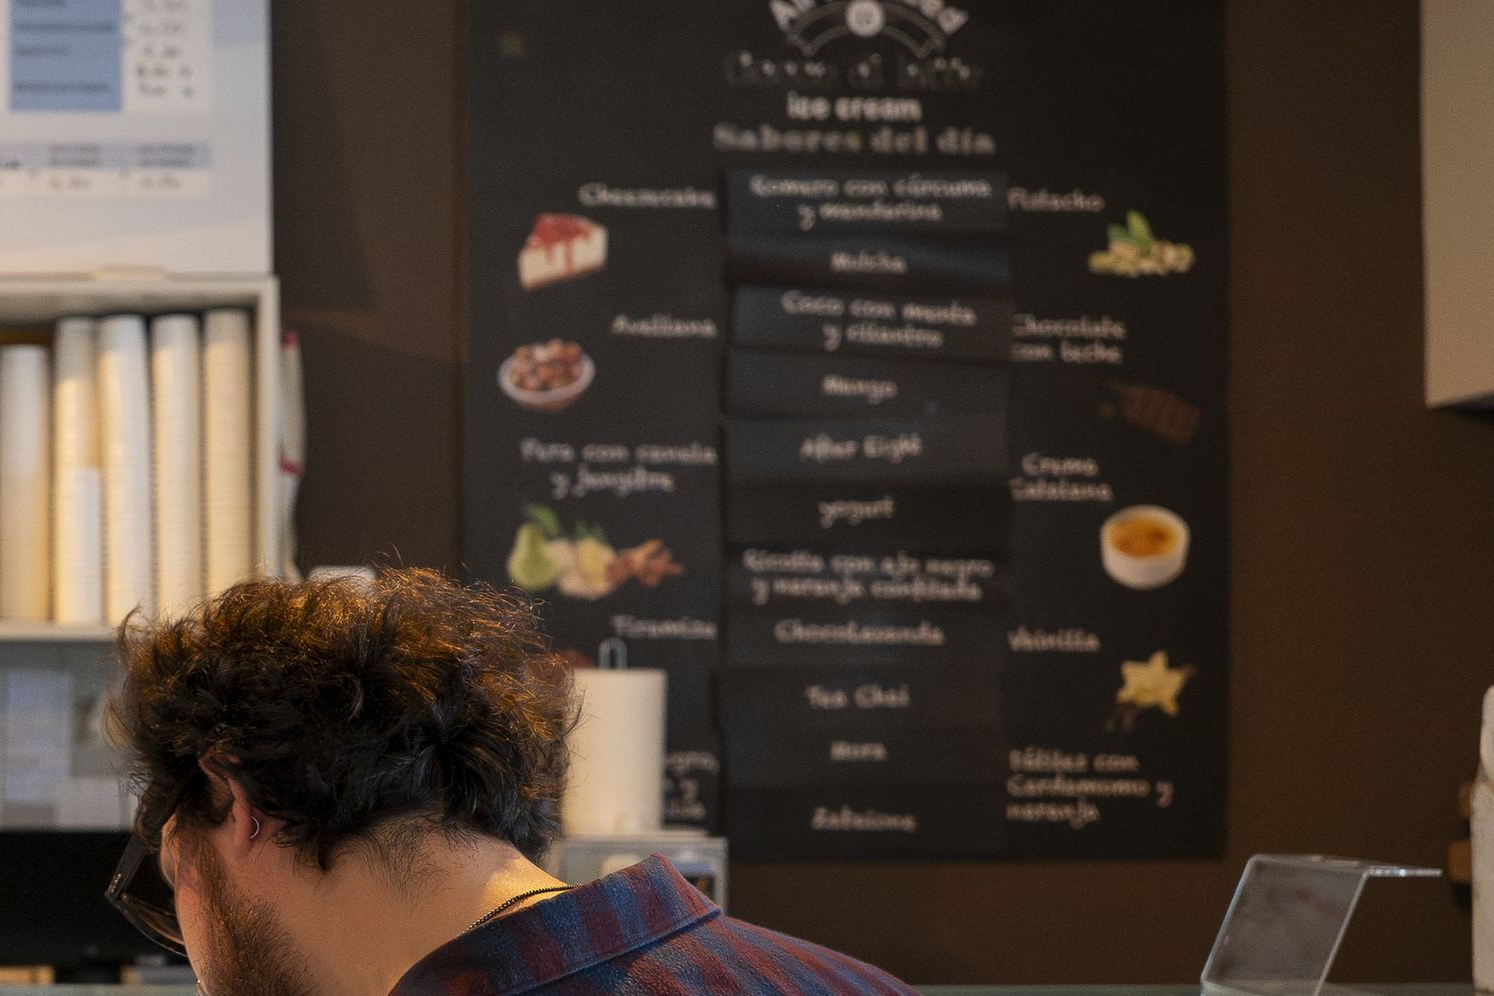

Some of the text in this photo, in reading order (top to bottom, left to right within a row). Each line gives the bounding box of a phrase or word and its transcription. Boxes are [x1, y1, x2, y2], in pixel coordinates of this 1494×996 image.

[835, 97, 922, 121] cream
[713, 121, 863, 151] Sabores
[870, 126, 928, 153] del
[781, 290, 845, 316] Coco
[850, 298, 895, 319] con
[581, 443, 629, 463] con
